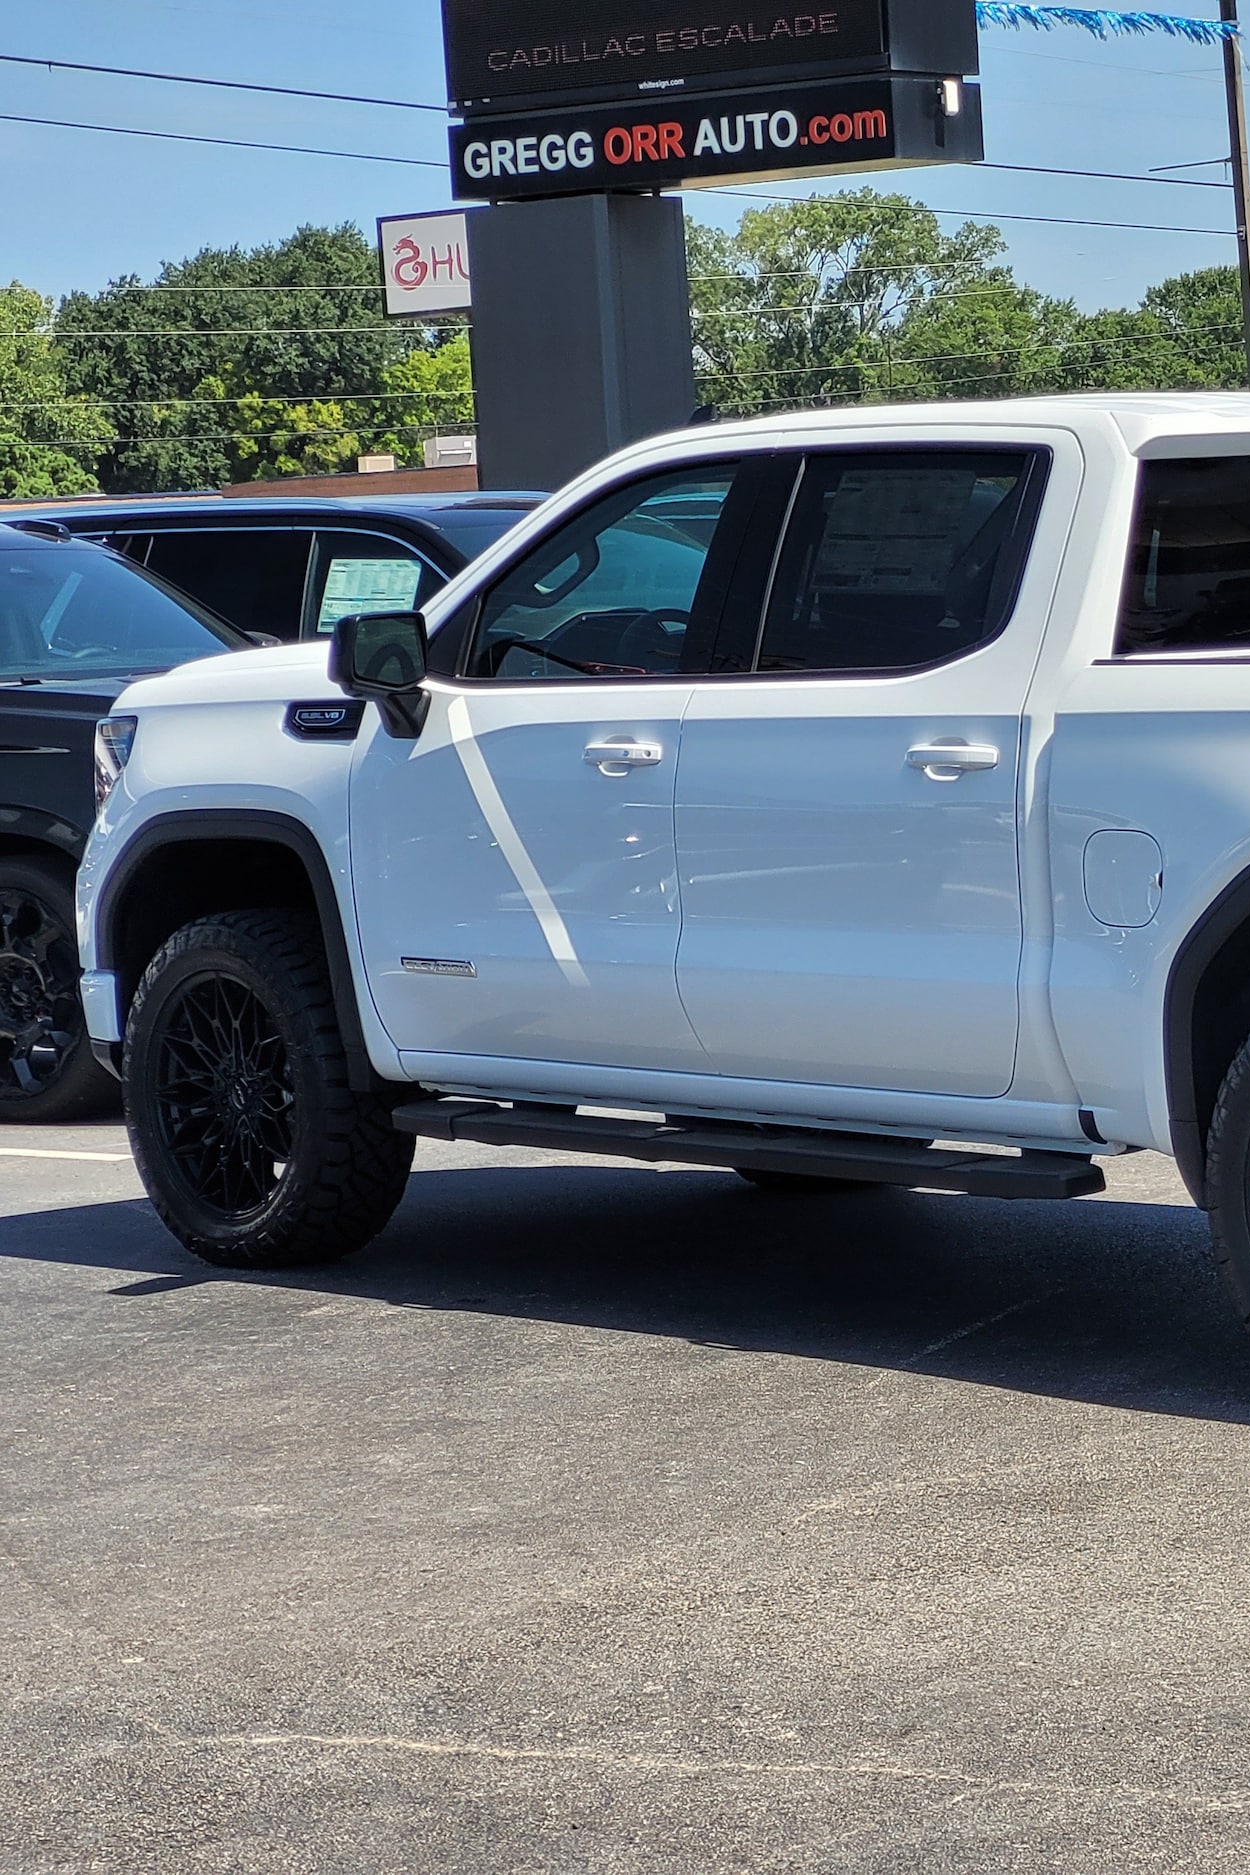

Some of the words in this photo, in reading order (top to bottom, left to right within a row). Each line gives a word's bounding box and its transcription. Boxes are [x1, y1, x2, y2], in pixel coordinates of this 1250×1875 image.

[487, 35, 646, 71] CADILLAC
[655, 12, 839, 52] ESCALADE
[638, 79, 685, 89] whitesign.com
[463, 131, 594, 178] GREGG
[603, 121, 685, 165] ORR
[693, 110, 887, 156] AUTO.com
